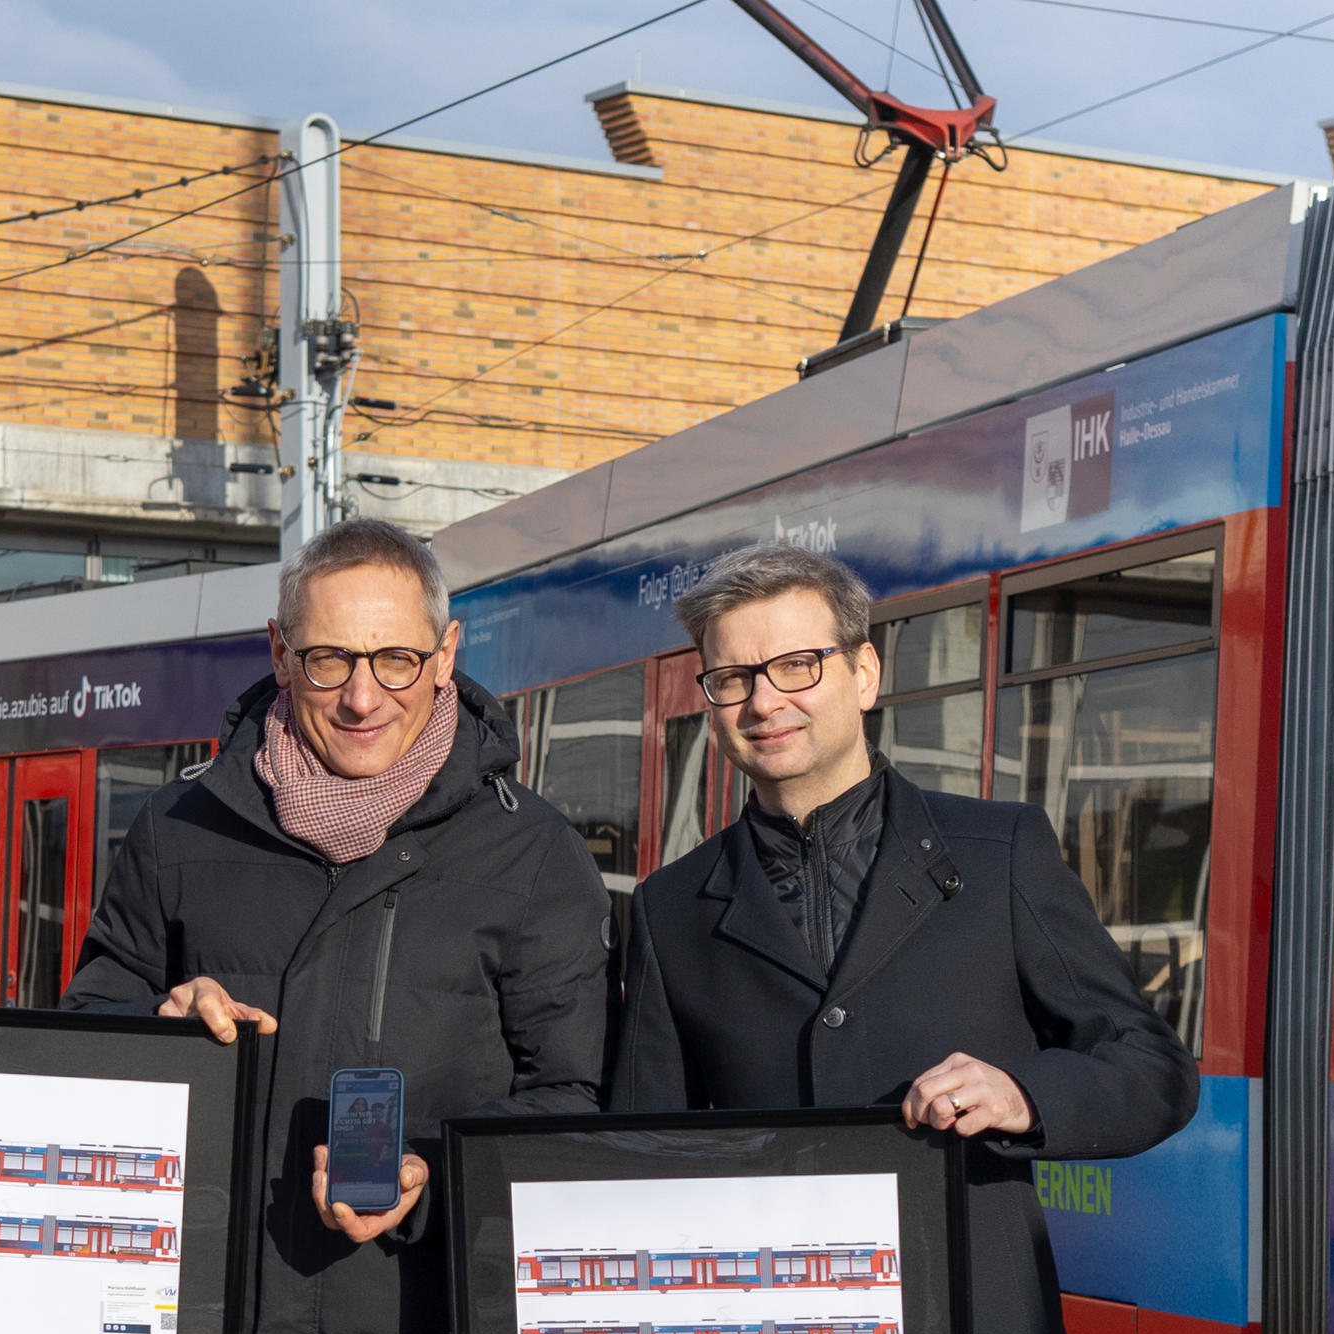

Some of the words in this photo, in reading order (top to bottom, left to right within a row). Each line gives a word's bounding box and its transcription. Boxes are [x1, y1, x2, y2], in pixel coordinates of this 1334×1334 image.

[1159, 388, 1175, 412] und
[1073, 410, 1111, 462] IHK
[638, 571, 668, 610] Folge
[49, 689, 71, 714] auf
[93, 681, 142, 710] TikTok
[1036, 1160, 1112, 1216] ERNEN
